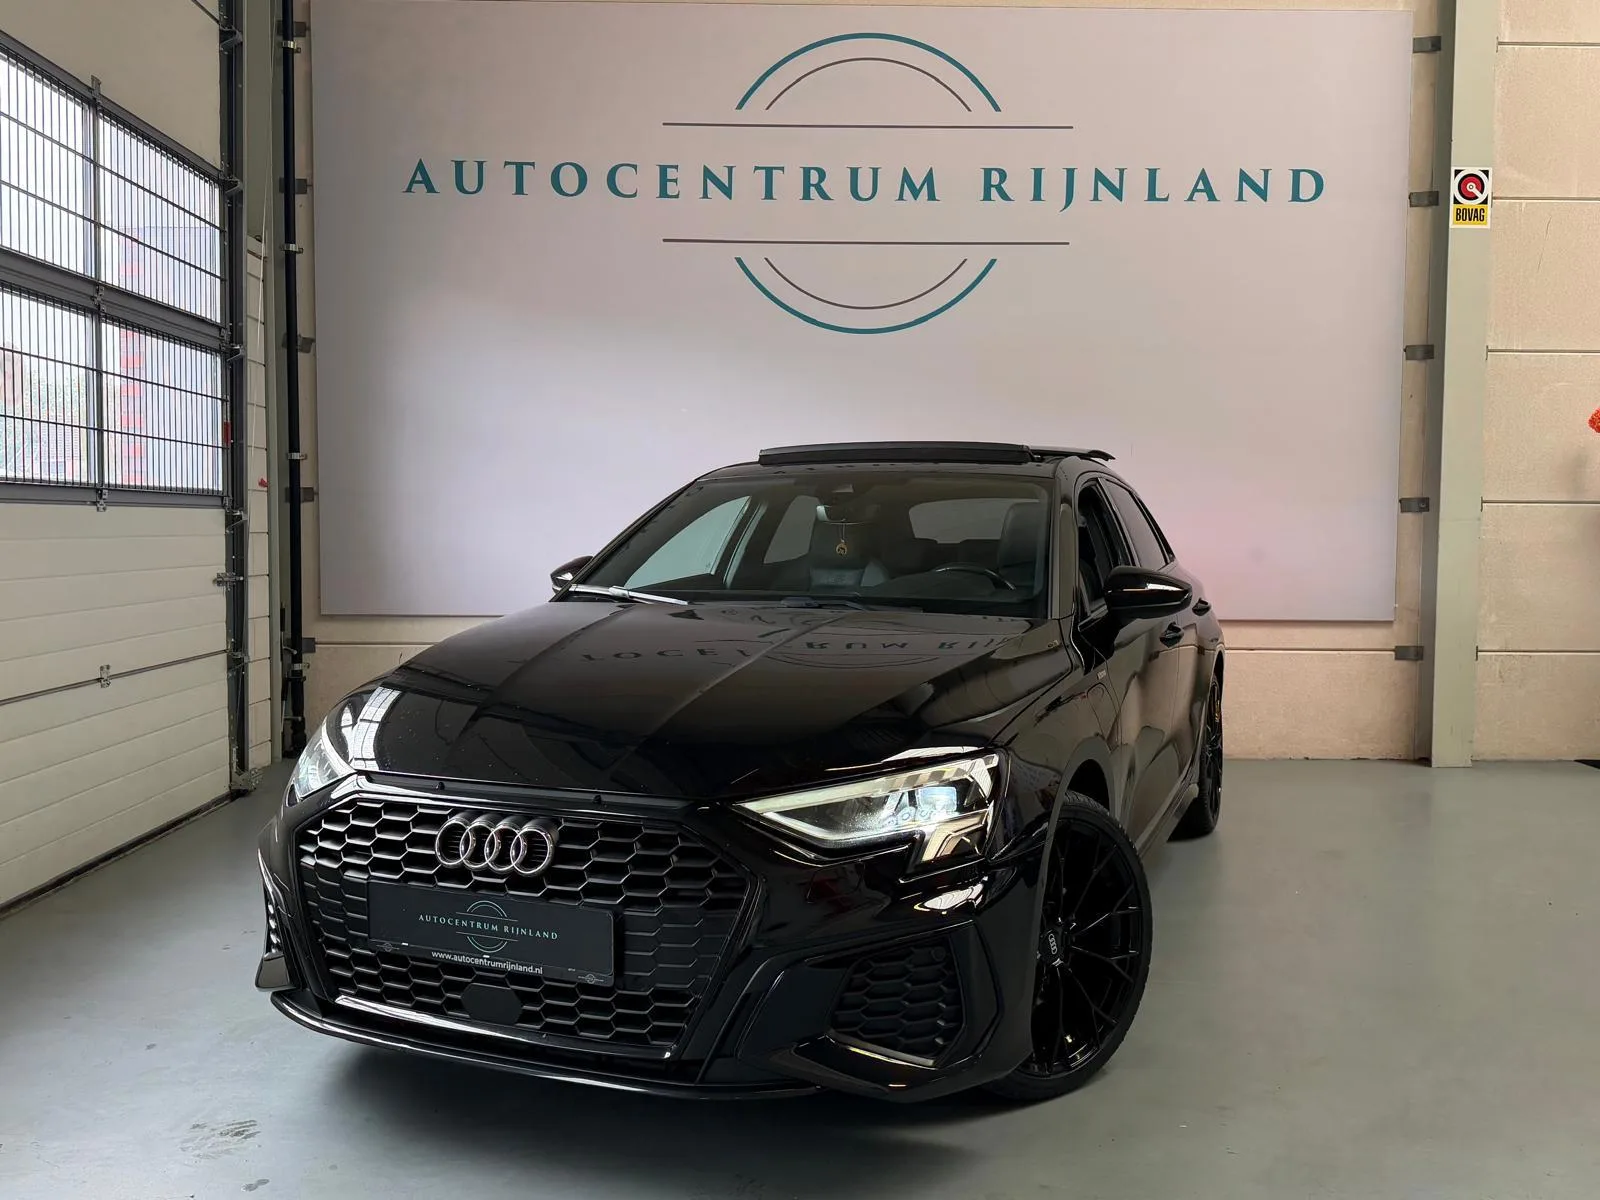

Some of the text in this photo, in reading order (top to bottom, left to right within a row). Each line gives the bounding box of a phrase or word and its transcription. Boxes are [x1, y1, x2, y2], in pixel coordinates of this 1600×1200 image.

[402, 157, 1325, 213] AUTOCENTRUM RIJNLAND
[1455, 207, 1485, 222] BOVAG
[418, 914, 558, 940] AUTOCENTRUM RIJNLAND
[431, 950, 543, 975] www.autocentrumrijnland.nl
